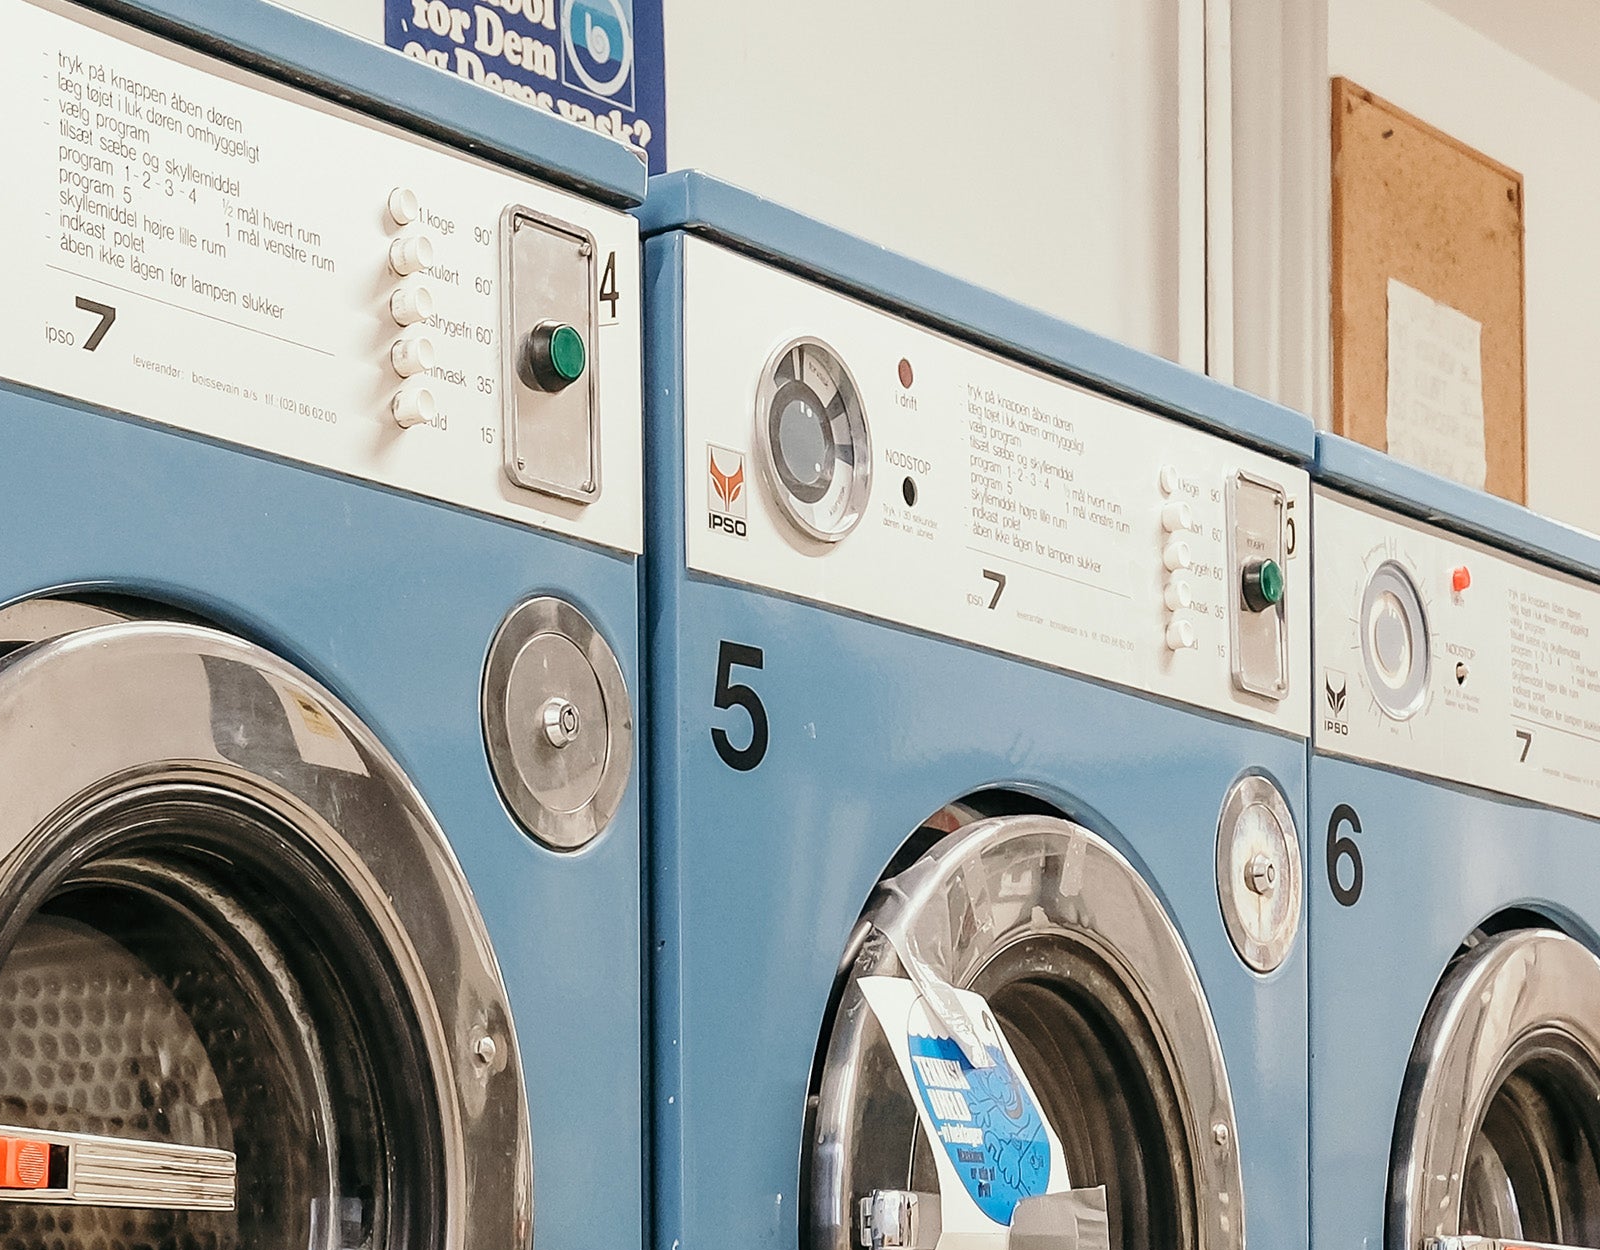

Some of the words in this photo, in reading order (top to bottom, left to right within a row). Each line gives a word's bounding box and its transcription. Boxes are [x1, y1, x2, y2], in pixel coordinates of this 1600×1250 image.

[473, 4, 558, 81] Dem
[57, 49, 84, 75] tryk
[88, 64, 106, 83] på
[111, 68, 167, 106] knappen
[170, 91, 203, 119] åben
[206, 106, 243, 134] døren
[57, 71, 82, 101] læg
[86, 82, 114, 109] tøjet
[124, 96, 143, 120] luk
[146, 106, 183, 135] døren
[186, 123, 261, 165] omhyggeligt
[59, 98, 90, 127] vælg
[96, 112, 150, 144] program
[59, 118, 93, 146] tilsæt
[100, 136, 137, 161] sæbe
[142, 151, 160, 174] og
[165, 158, 241, 198] skyllemiddel
[59, 145, 114, 177] program
[237, 206, 260, 227] mål
[263, 211, 294, 239] hvert
[297, 227, 322, 248] rum
[59, 167, 115, 200] program
[122, 185, 133, 205] 5
[224, 221, 231, 239] 1
[237, 228, 261, 248] mål
[263, 236, 308, 264] venstre
[311, 252, 336, 273] rum
[59, 187, 138, 229] skyllemiddel
[143, 213, 176, 241] højre
[179, 225, 198, 249] lille
[201, 238, 227, 259] rum
[59, 208, 106, 241] indkast
[113, 230, 146, 254] polet
[60, 231, 94, 260] åben
[99, 244, 126, 269] ikke
[130, 254, 165, 283] lågen
[169, 267, 188, 289] før
[191, 274, 238, 305] lampen
[241, 292, 286, 320] slukker
[599, 250, 620, 319] 4
[45, 321, 76, 346] ipso
[75, 295, 117, 352] 7
[708, 512, 747, 537] IPSO
[982, 568, 1006, 610] 7
[710, 639, 769, 772] 5
[1323, 719, 1350, 737] IPSO
[1516, 729, 1532, 763] 7
[1326, 803, 1363, 907] 6
